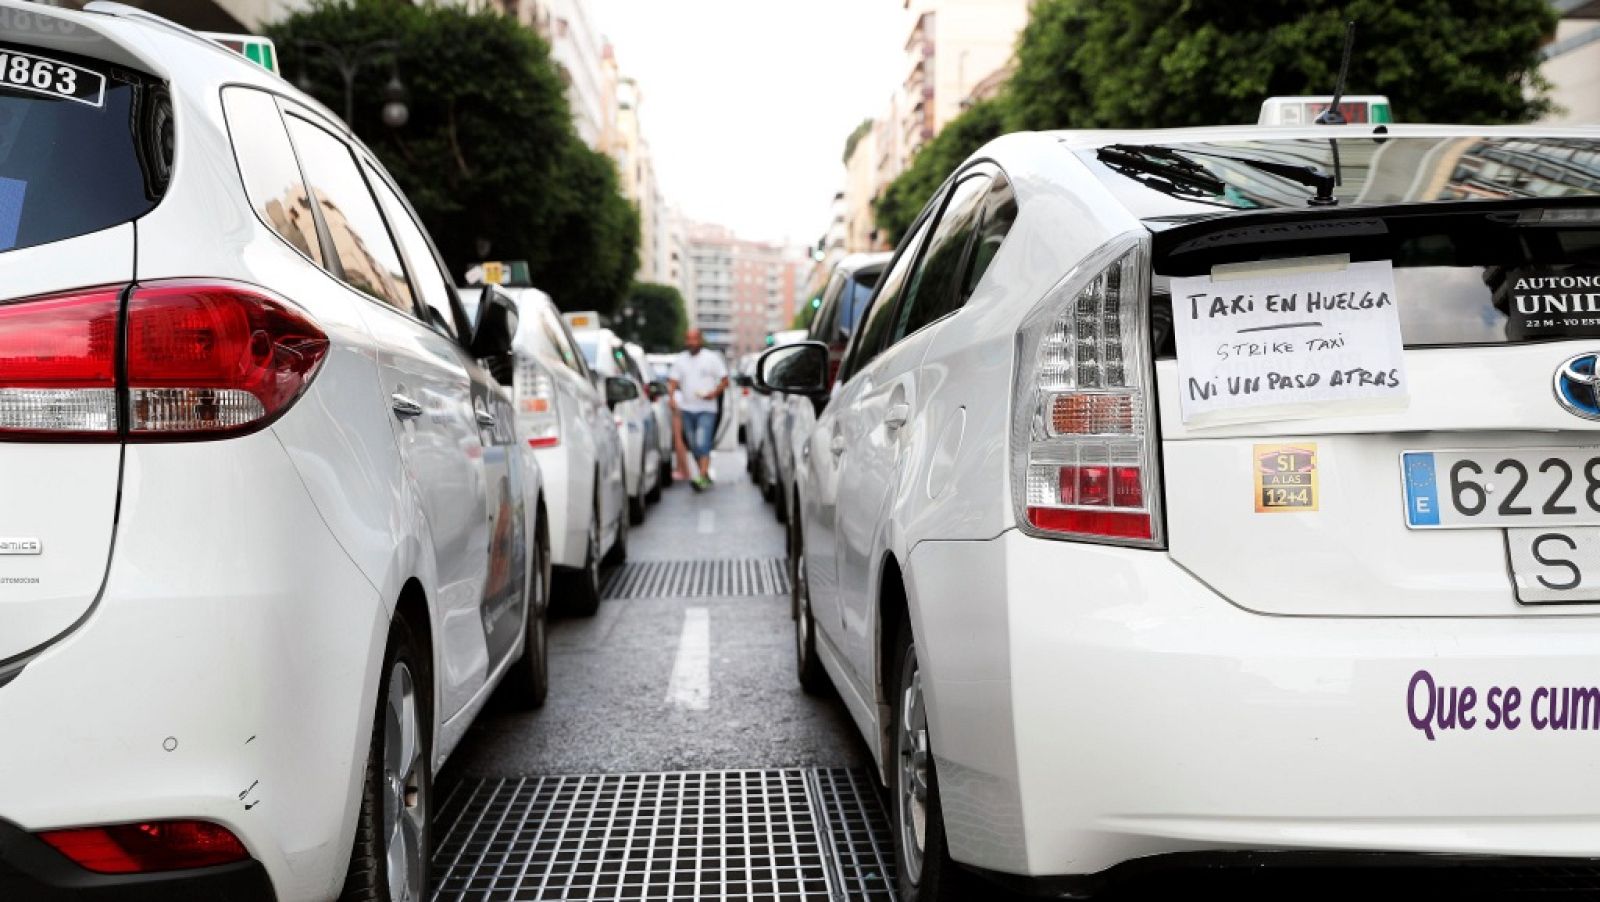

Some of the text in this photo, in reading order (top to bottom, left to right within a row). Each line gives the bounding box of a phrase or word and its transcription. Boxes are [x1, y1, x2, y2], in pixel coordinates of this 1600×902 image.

[1266, 293, 1297, 312] EN
[1307, 291, 1392, 313] HUELGA
[1515, 293, 1600, 314] UNID
[1526, 319, 1540, 328] 22
[1543, 319, 1554, 327] M
[1563, 318, 1579, 326] YO
[1228, 376, 1260, 394] UN
[1267, 372, 1321, 390] PASO
[1329, 368, 1400, 388] ATRAS
[1277, 454, 1295, 472] SI
[1272, 474, 1301, 484] A LAS
[1266, 488, 1309, 505] 12+4
[1416, 497, 1430, 513] E
[1531, 533, 1582, 590] S
[1407, 670, 1600, 741] Que se cum
